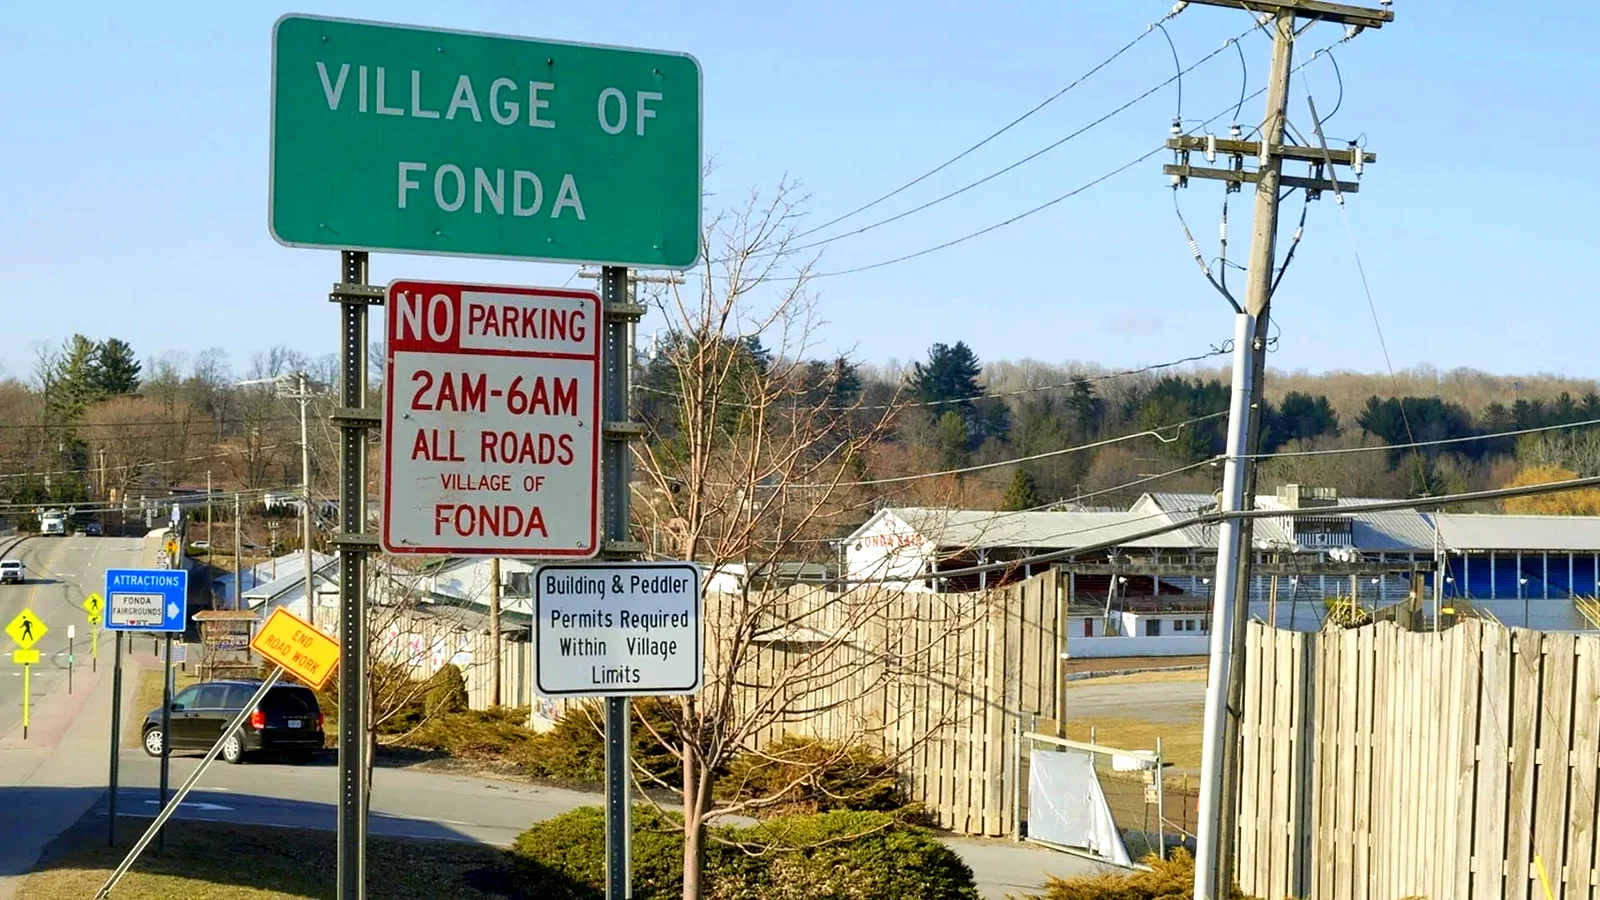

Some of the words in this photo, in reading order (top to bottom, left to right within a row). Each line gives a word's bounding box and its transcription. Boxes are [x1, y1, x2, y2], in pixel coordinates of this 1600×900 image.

[315, 61, 556, 129] VILLAGE
[597, 87, 663, 136] OF
[397, 161, 586, 221] FONDA
[395, 292, 455, 343] NO
[468, 304, 586, 343] PARKING
[411, 370, 578, 416] 2AM-6AM
[411, 429, 465, 462] ALL
[480, 431, 574, 466] ROADS
[440, 473, 511, 491] VILLAGE
[523, 475, 545, 492] OF
[435, 503, 548, 538] FONDA
[858, 534, 894, 548] ONDA
[113, 575, 179, 586] ATTRACTIONS
[546, 575, 606, 600] Building
[611, 574, 624, 594] &
[630, 575, 689, 594] Peddler
[113, 607, 162, 616] FAIRGROUNDS
[123, 597, 151, 605] FONDA
[551, 609, 613, 628] Permits
[620, 609, 688, 632] Required
[292, 630, 314, 648] END
[559, 637, 607, 656] Within
[626, 637, 677, 660] Village
[265, 634, 292, 656] ROAD
[291, 651, 320, 674] WORK
[592, 665, 640, 684] Limits
